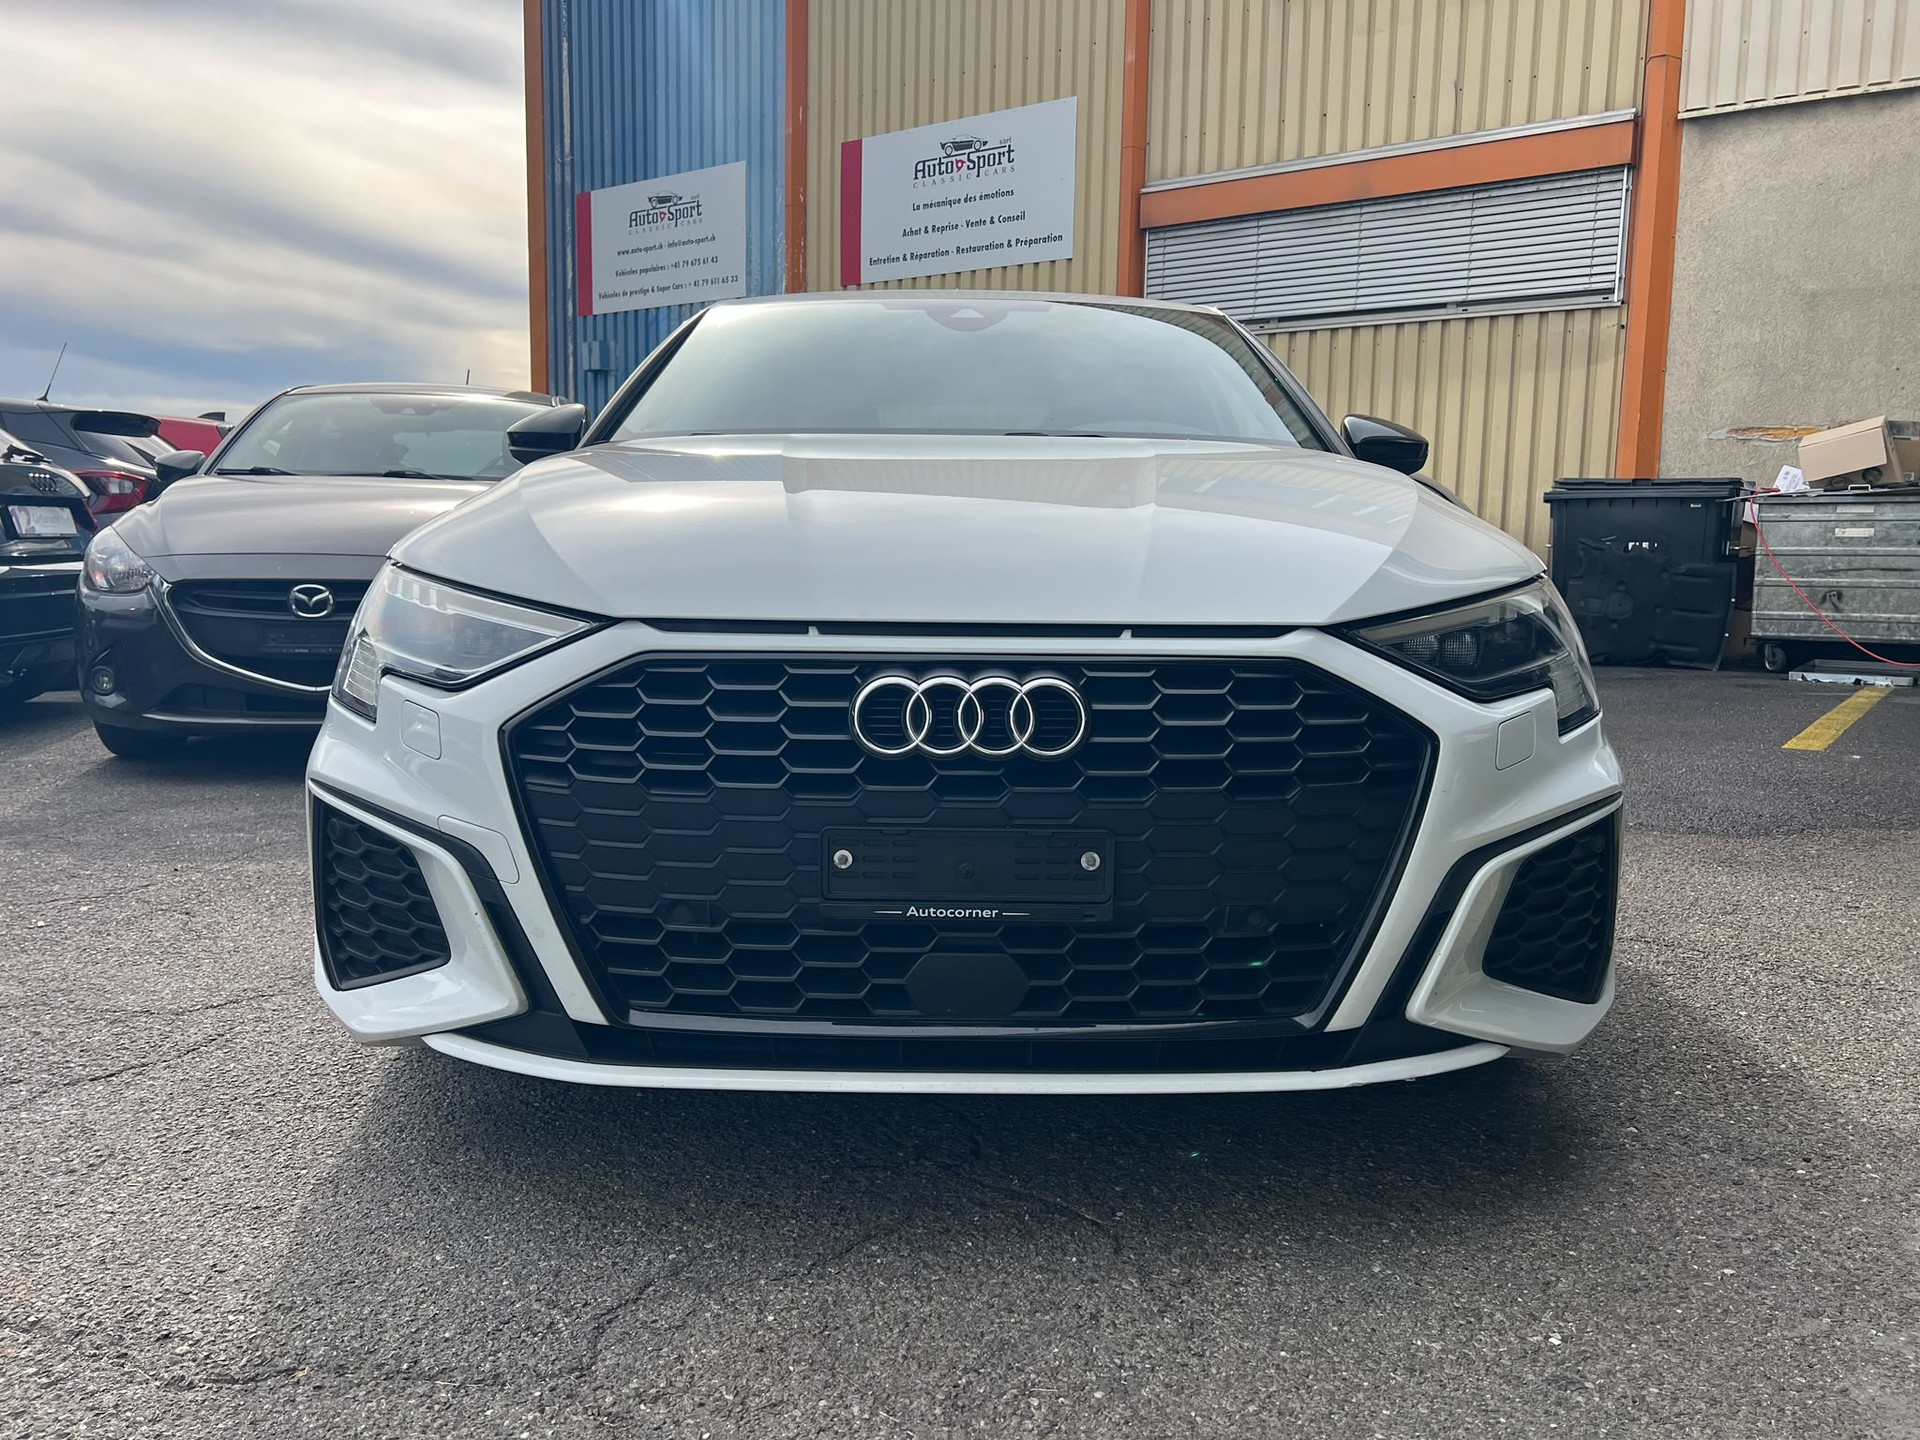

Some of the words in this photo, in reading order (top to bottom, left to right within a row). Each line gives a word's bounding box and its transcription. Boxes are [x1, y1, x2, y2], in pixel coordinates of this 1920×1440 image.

[966, 144, 1015, 178] Sport
[913, 173, 972, 189] CLASSIC
[984, 165, 1015, 177] CARS
[912, 202, 921, 212] La
[922, 197, 961, 210] mécanique
[963, 193, 977, 204] des
[979, 188, 1015, 201] émotions
[667, 199, 702, 228] Sport
[902, 226, 922, 238] Achat
[923, 225, 930, 235] &
[931, 221, 960, 235] Reprise
[965, 218, 987, 229] Vente
[989, 215, 995, 225] &
[997, 210, 1026, 224] Conseil
[869, 254, 901, 266] Entretien
[902, 253, 908, 262] &
[909, 248, 950, 263] Réparation
[955, 240, 1005, 255] Restauration
[1006, 238, 1013, 248] &
[1015, 232, 1063, 248] Préparation
[682, 259, 689, 268] 79
[622, 289, 629, 297] de
[672, 282, 684, 291] Cars
[906, 905, 999, 918] Autocorner
